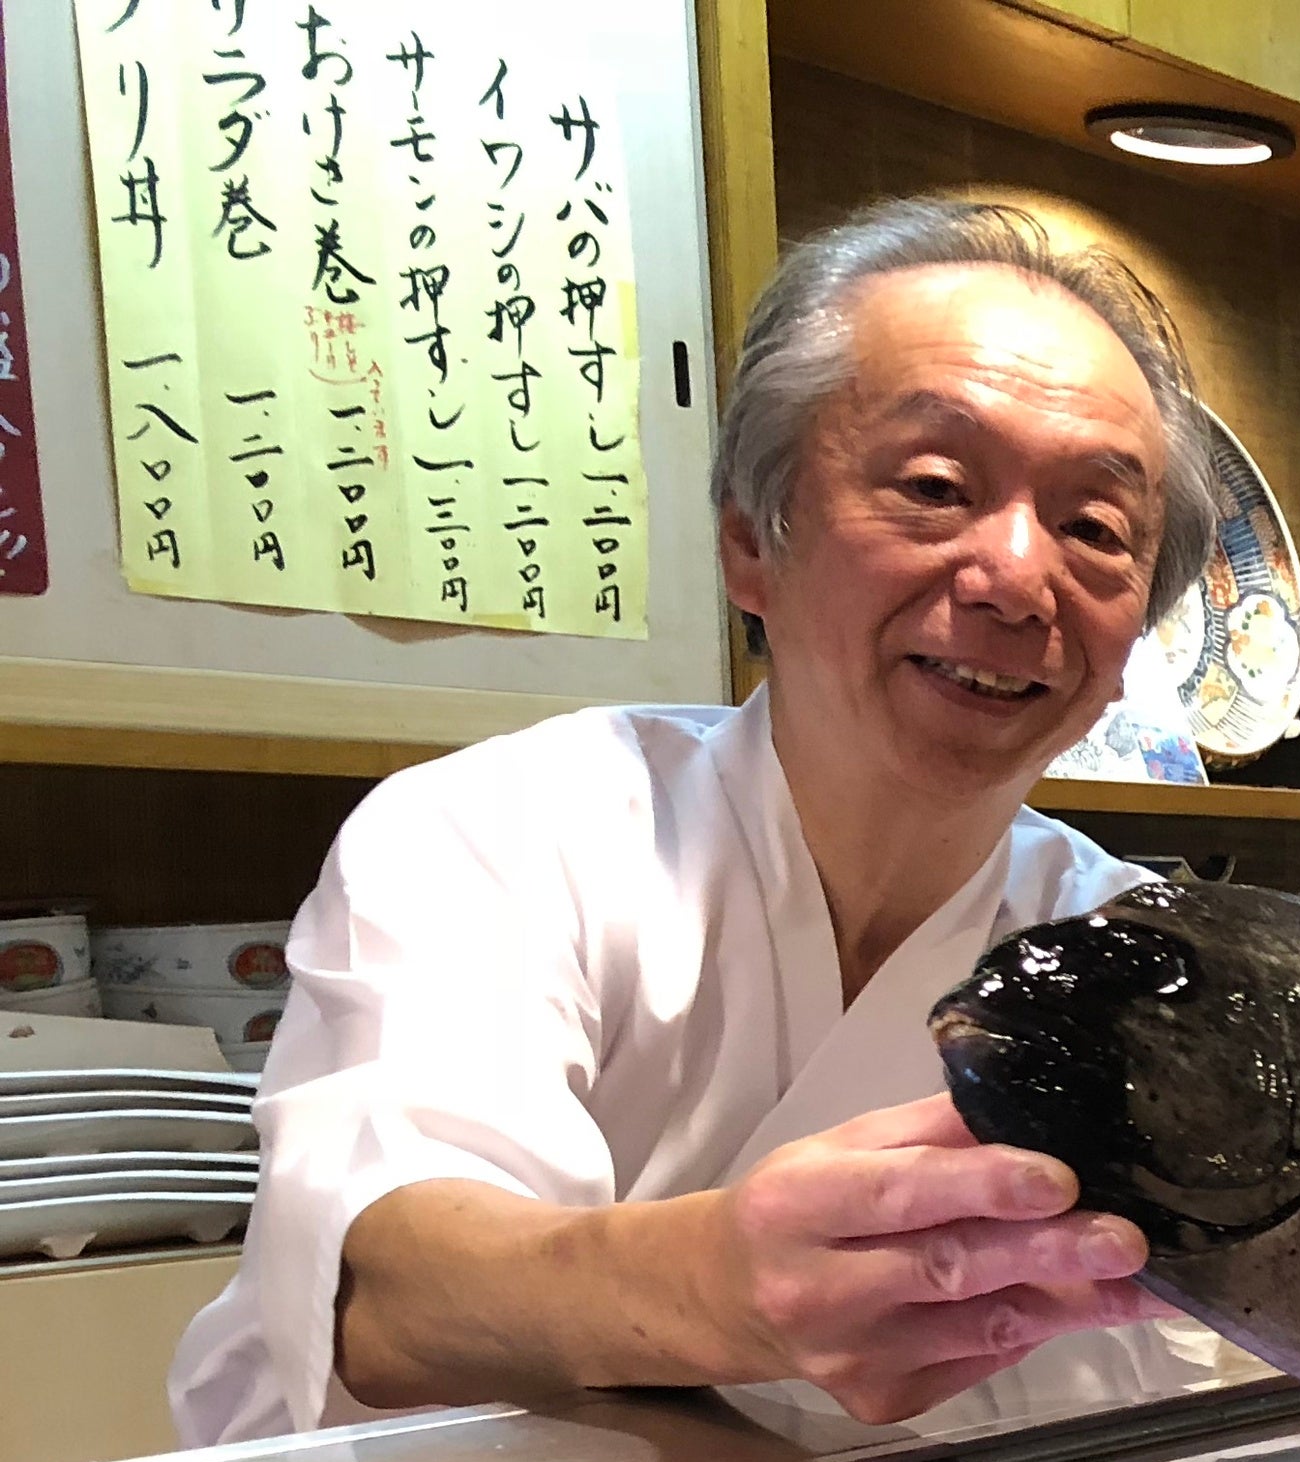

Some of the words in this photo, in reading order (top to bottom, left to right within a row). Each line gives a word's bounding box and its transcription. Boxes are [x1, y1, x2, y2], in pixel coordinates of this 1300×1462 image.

[105, 0, 168, 269] リ丼
[295, 4, 377, 304] おけさ巻
